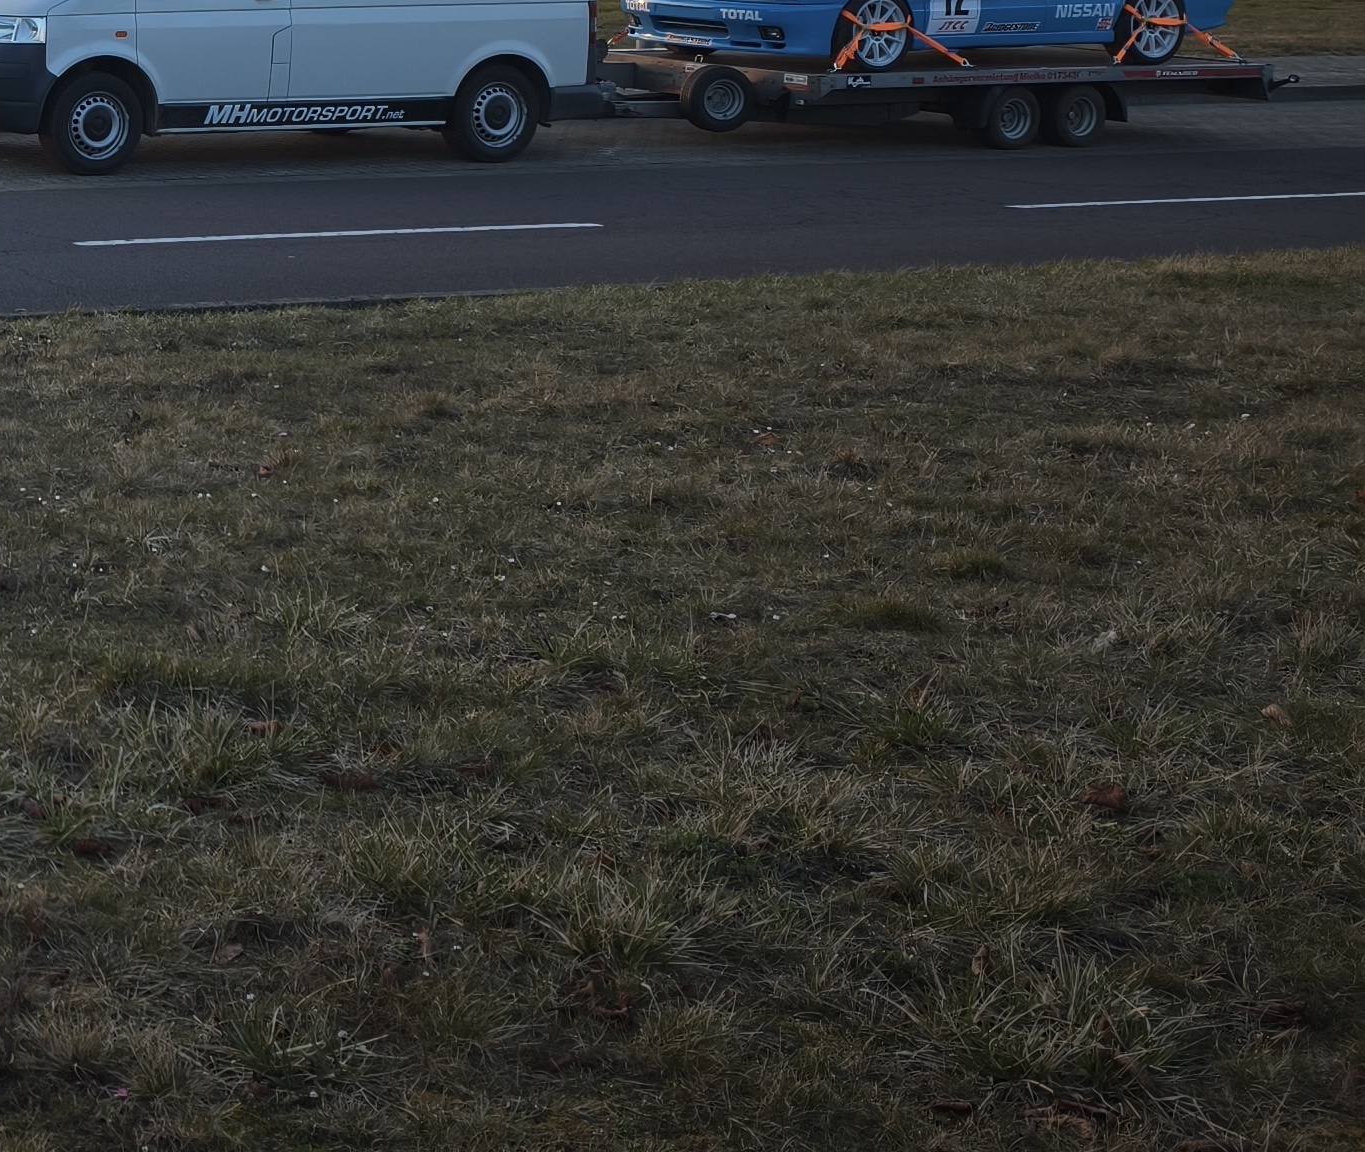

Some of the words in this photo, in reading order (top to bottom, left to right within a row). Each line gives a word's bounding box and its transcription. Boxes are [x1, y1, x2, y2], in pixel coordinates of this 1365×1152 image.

[625, 0, 651, 13] TOTAL
[1055, 3, 1116, 18] NISSAN
[720, 8, 763, 21] TOTAL
[938, 20, 969, 31] JTCC
[203, 103, 405, 125] MHMOTORSPORT.net
